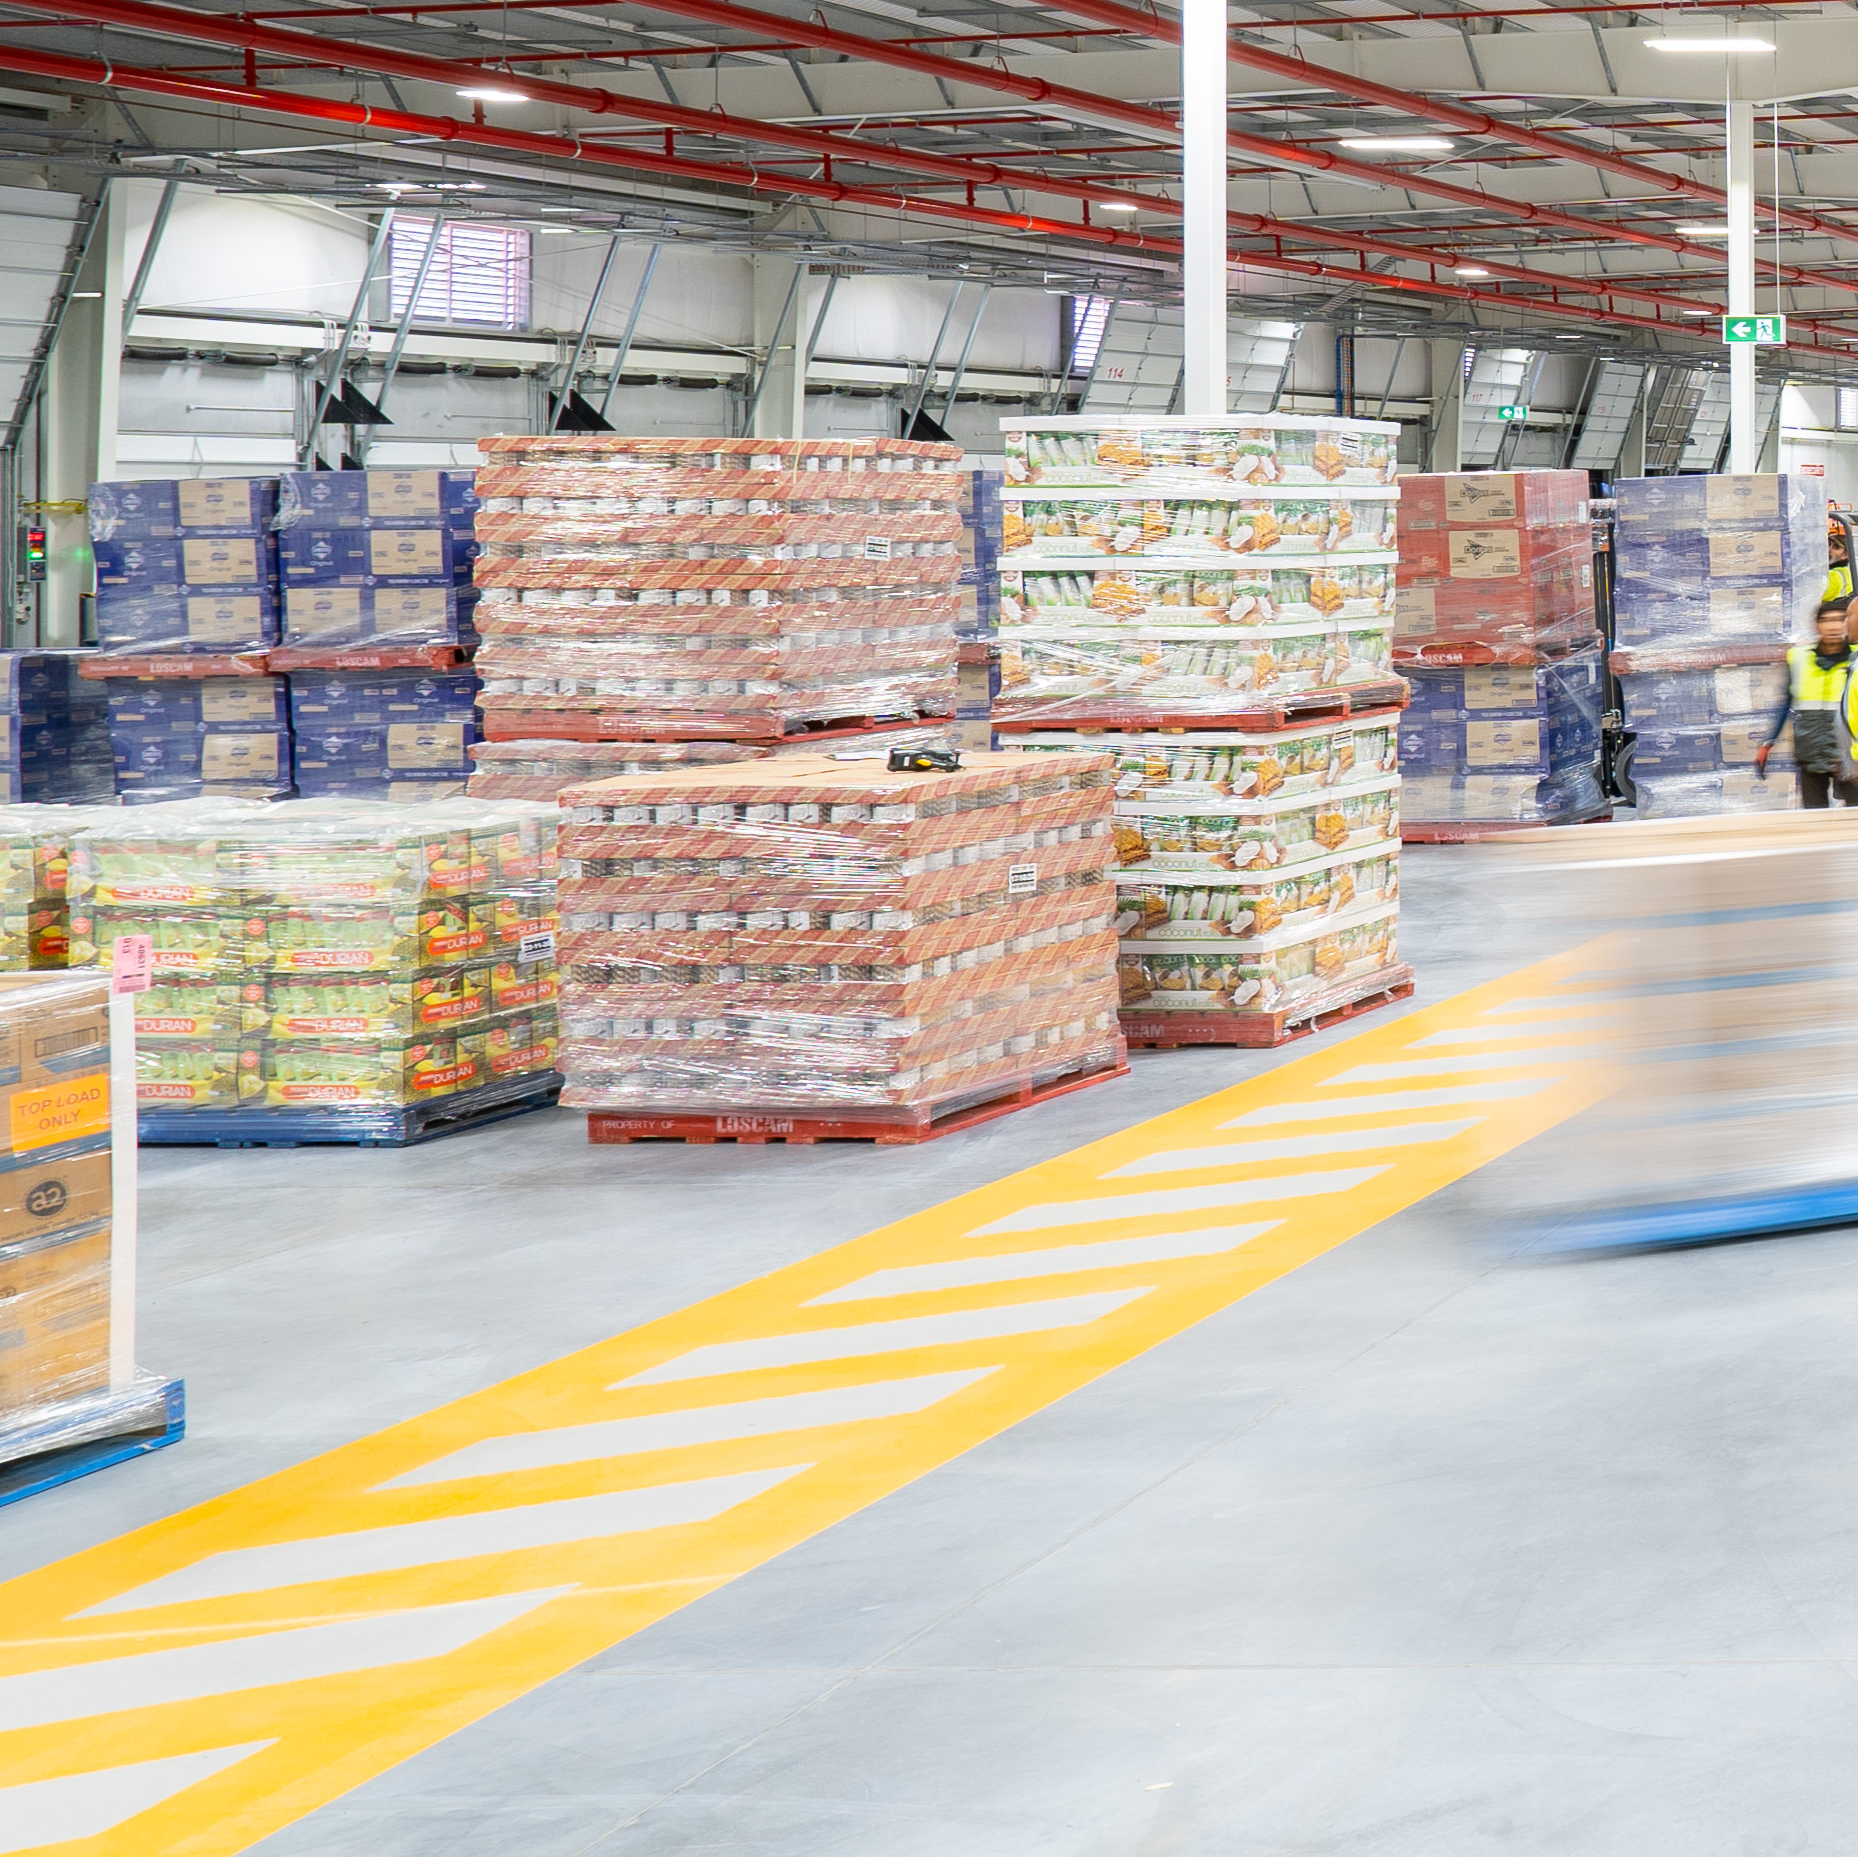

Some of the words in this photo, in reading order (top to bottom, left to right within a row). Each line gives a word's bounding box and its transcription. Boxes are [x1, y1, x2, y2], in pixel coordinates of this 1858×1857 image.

[336, 657, 381, 667] LOSCAM
[1425, 653, 1463, 663] OSCAM
[149, 662, 194, 673] LOSCAM
[1152, 858, 1198, 869] coconut
[1158, 927, 1202, 937] coconut
[151, 953, 194, 965] URIAN
[319, 953, 369, 964] DURIAN
[1153, 997, 1197, 1007] coconut
[143, 1019, 192, 1031] DURIAN
[1123, 1024, 1166, 1038] SCAM
[146, 1085, 191, 1096] DURIAN
[18, 1099, 52, 1118] TOP
[56, 1087, 101, 1108] LOAD
[37, 1109, 81, 1131] ONLY
[602, 1120, 655, 1129] PROPERTY
[662, 1120, 675, 1129] OF
[715, 1116, 793, 1133] LOSCAM
[31, 1186, 64, 1213] a2
